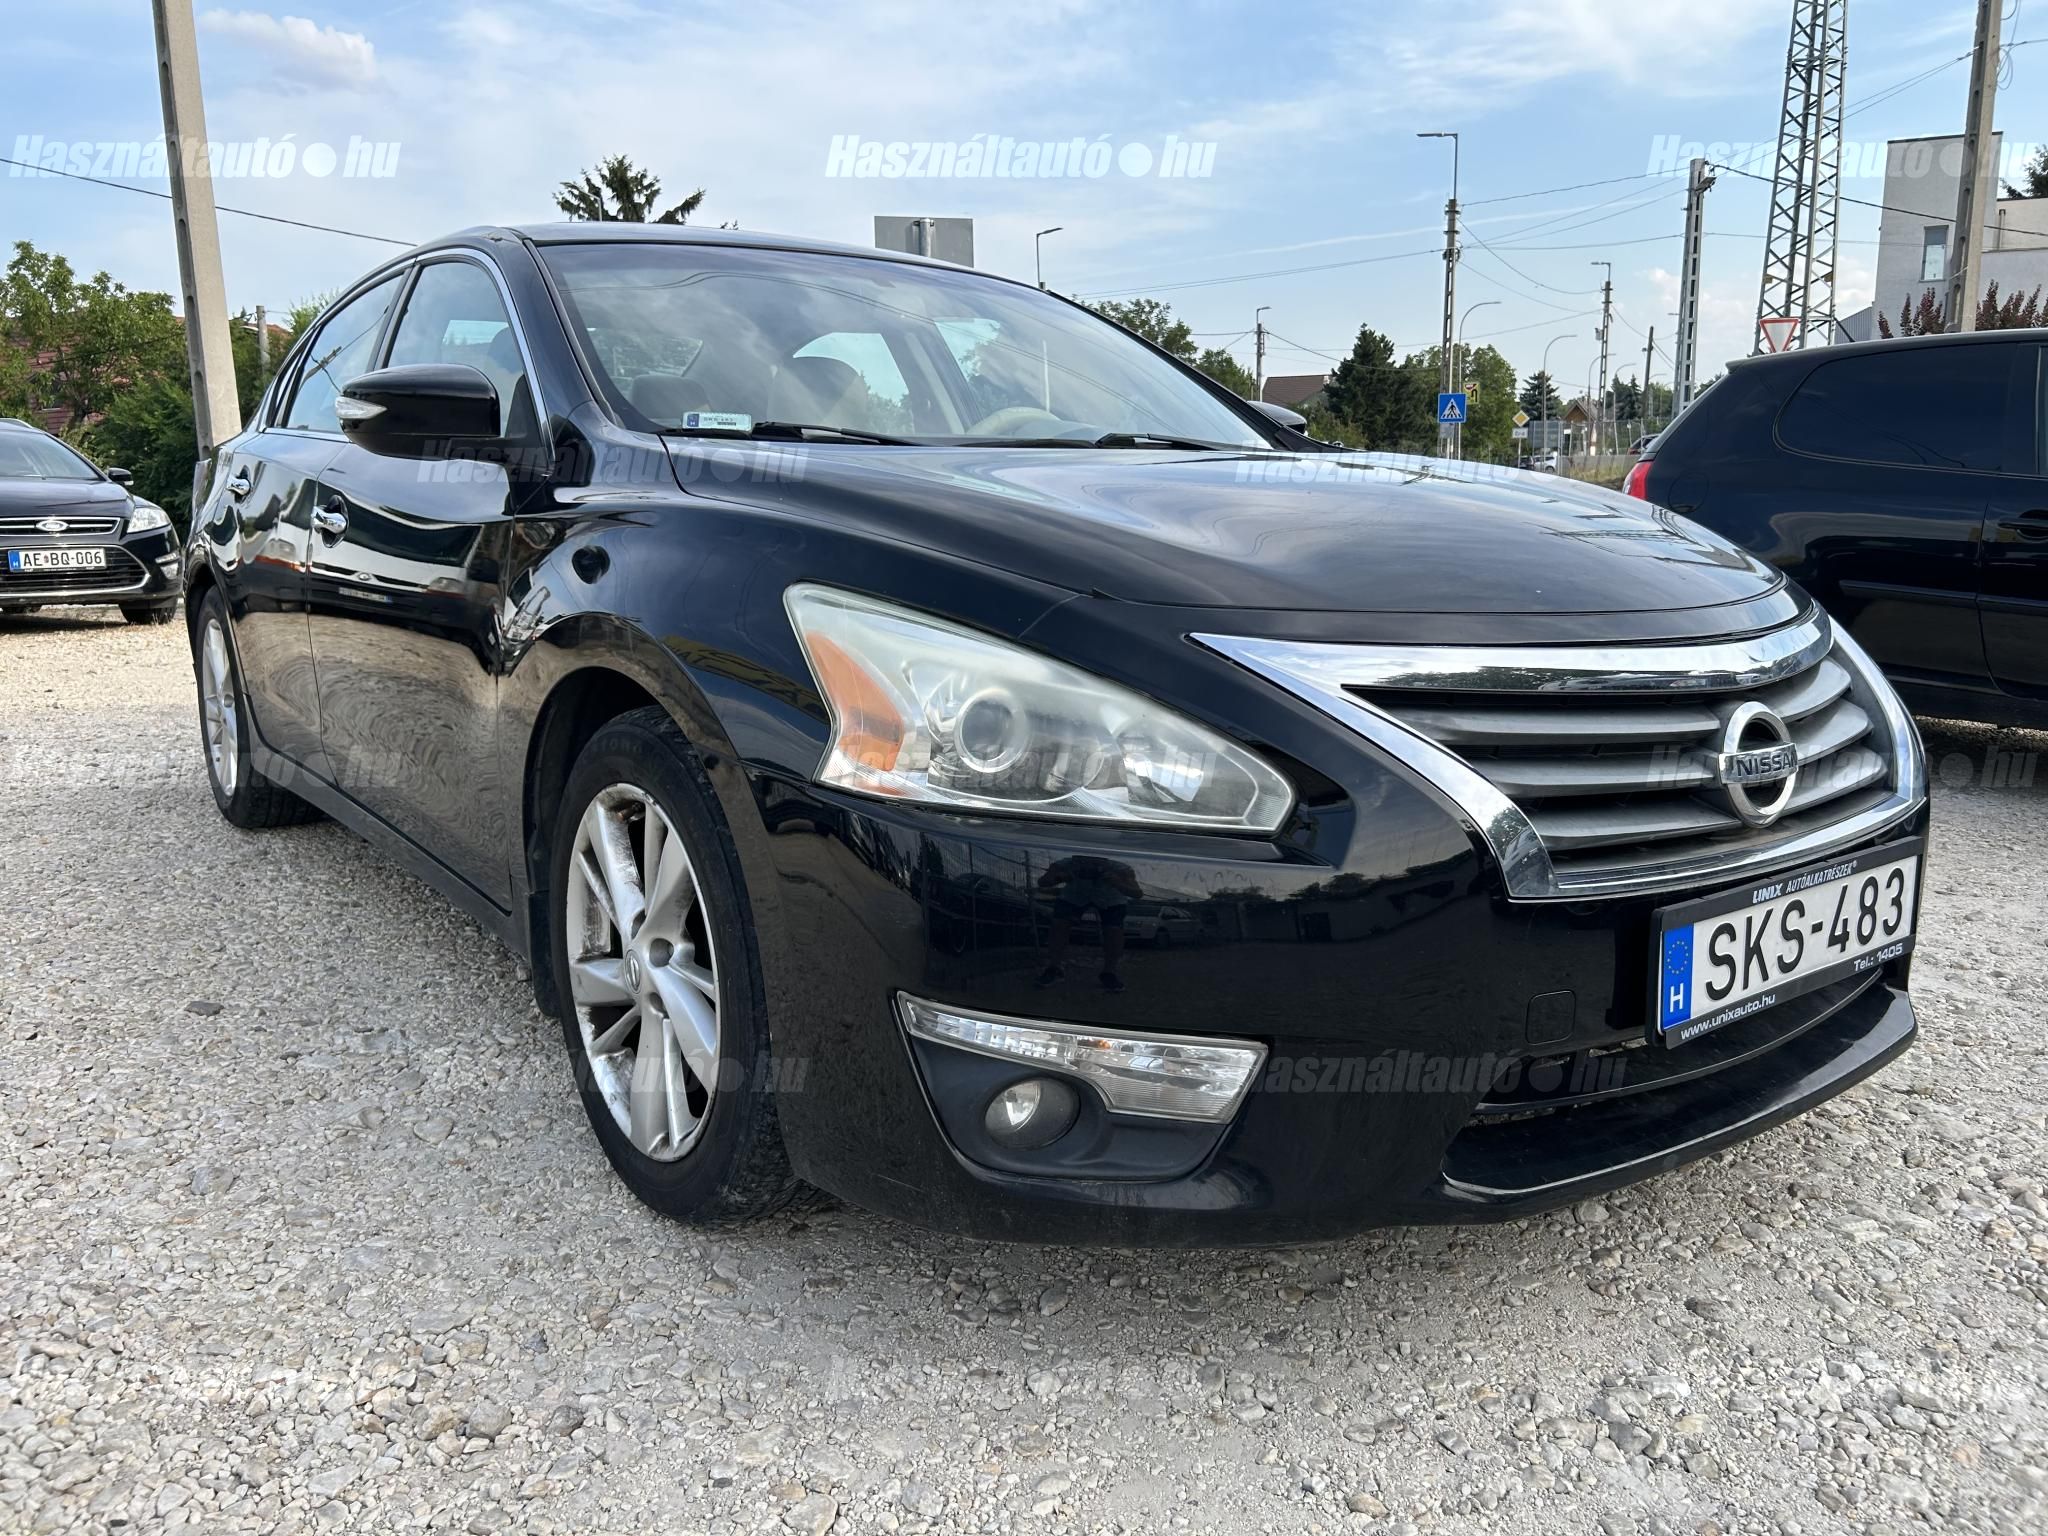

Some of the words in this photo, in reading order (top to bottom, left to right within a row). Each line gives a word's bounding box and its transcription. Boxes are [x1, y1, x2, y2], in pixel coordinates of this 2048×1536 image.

[23, 553, 43, 566] AE
[50, 551, 102, 566] BQ-006
[1736, 751, 1797, 776] NISSAN
[1752, 883, 1784, 903] UNIX
[1705, 867, 1905, 1001] SKS-483
[1854, 956, 1874, 972] Tel.:
[1876, 943, 1903, 963] 1405
[1669, 982, 1684, 1013] H
[1680, 993, 1776, 1040] www.unixauto.hu
